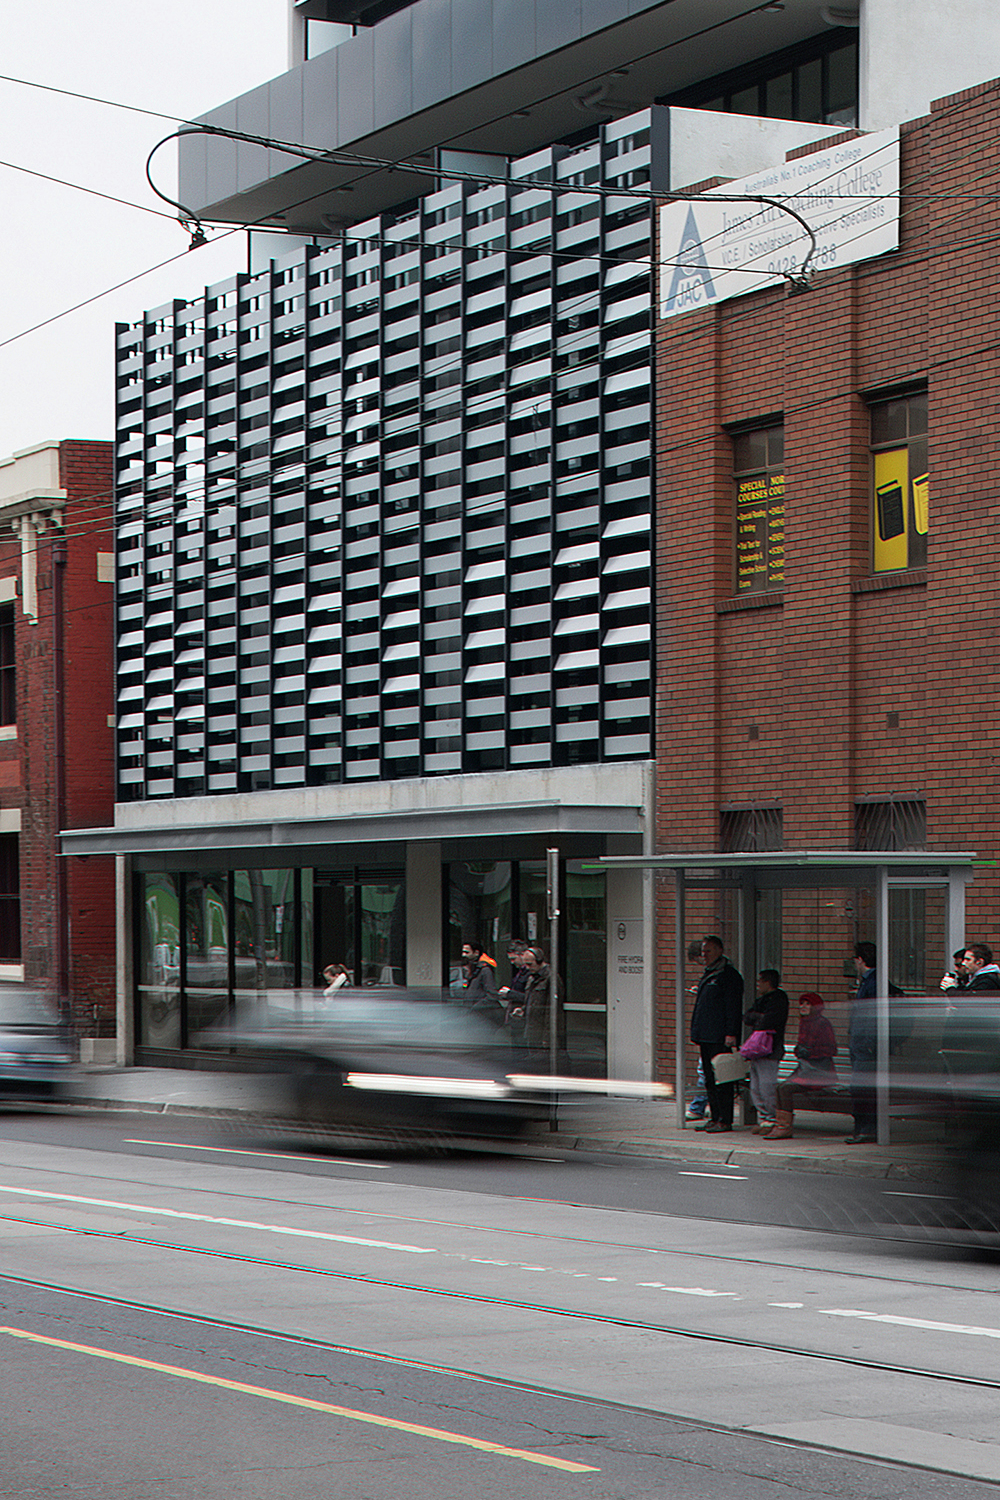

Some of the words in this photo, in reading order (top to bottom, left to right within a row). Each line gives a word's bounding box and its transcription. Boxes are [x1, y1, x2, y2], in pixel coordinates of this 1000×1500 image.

[797, 157, 831, 177] Coaching
[834, 148, 862, 164] College
[837, 166, 883, 198] College
[840, 205, 885, 230] Specialists
[676, 278, 702, 308] JAC
[739, 479, 766, 493] SPECIAL
[737, 489, 768, 503] COURSES
[617, 955, 628, 964] FIRE
[618, 966, 628, 974] AND
